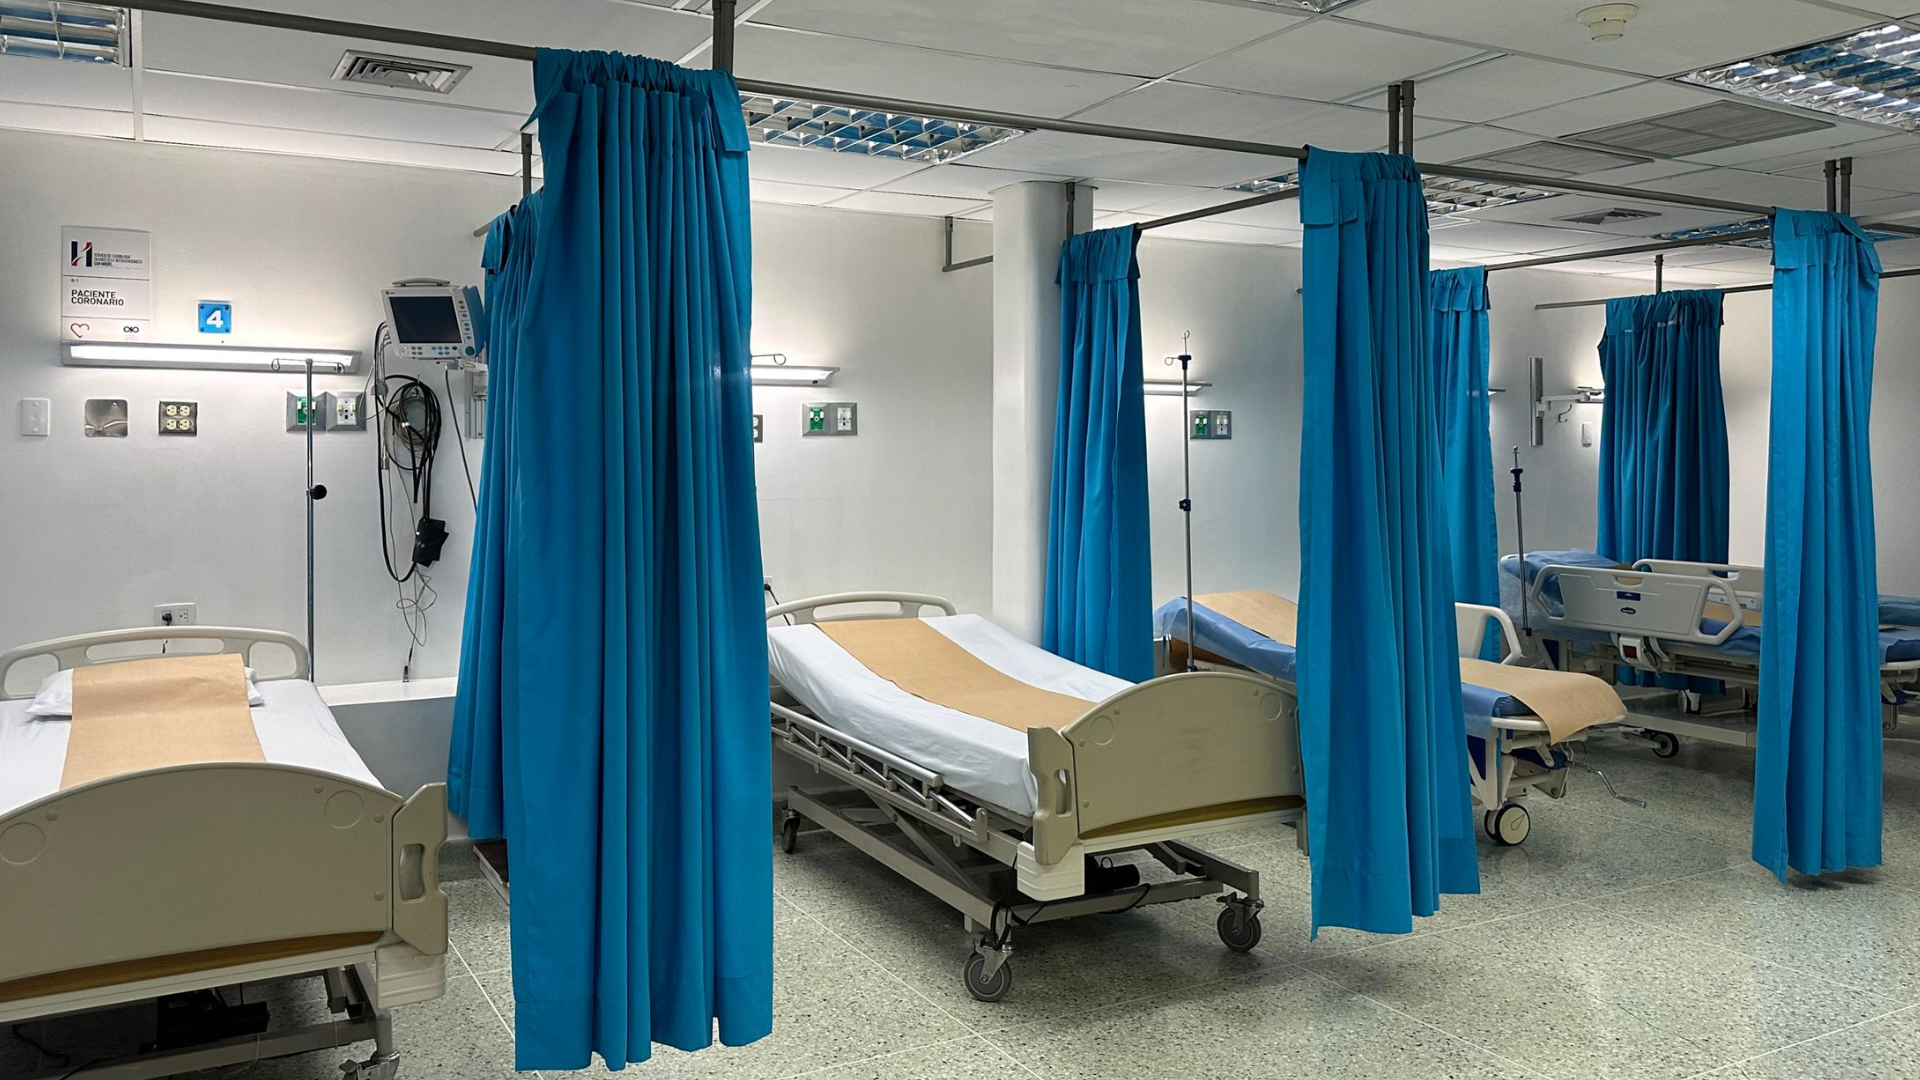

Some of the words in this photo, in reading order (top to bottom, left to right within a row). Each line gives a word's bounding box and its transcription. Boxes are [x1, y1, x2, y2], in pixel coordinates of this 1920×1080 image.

[71, 289, 116, 299] PACIENTE
[71, 297, 125, 306] CORONARIO
[206, 310, 224, 328] 4
